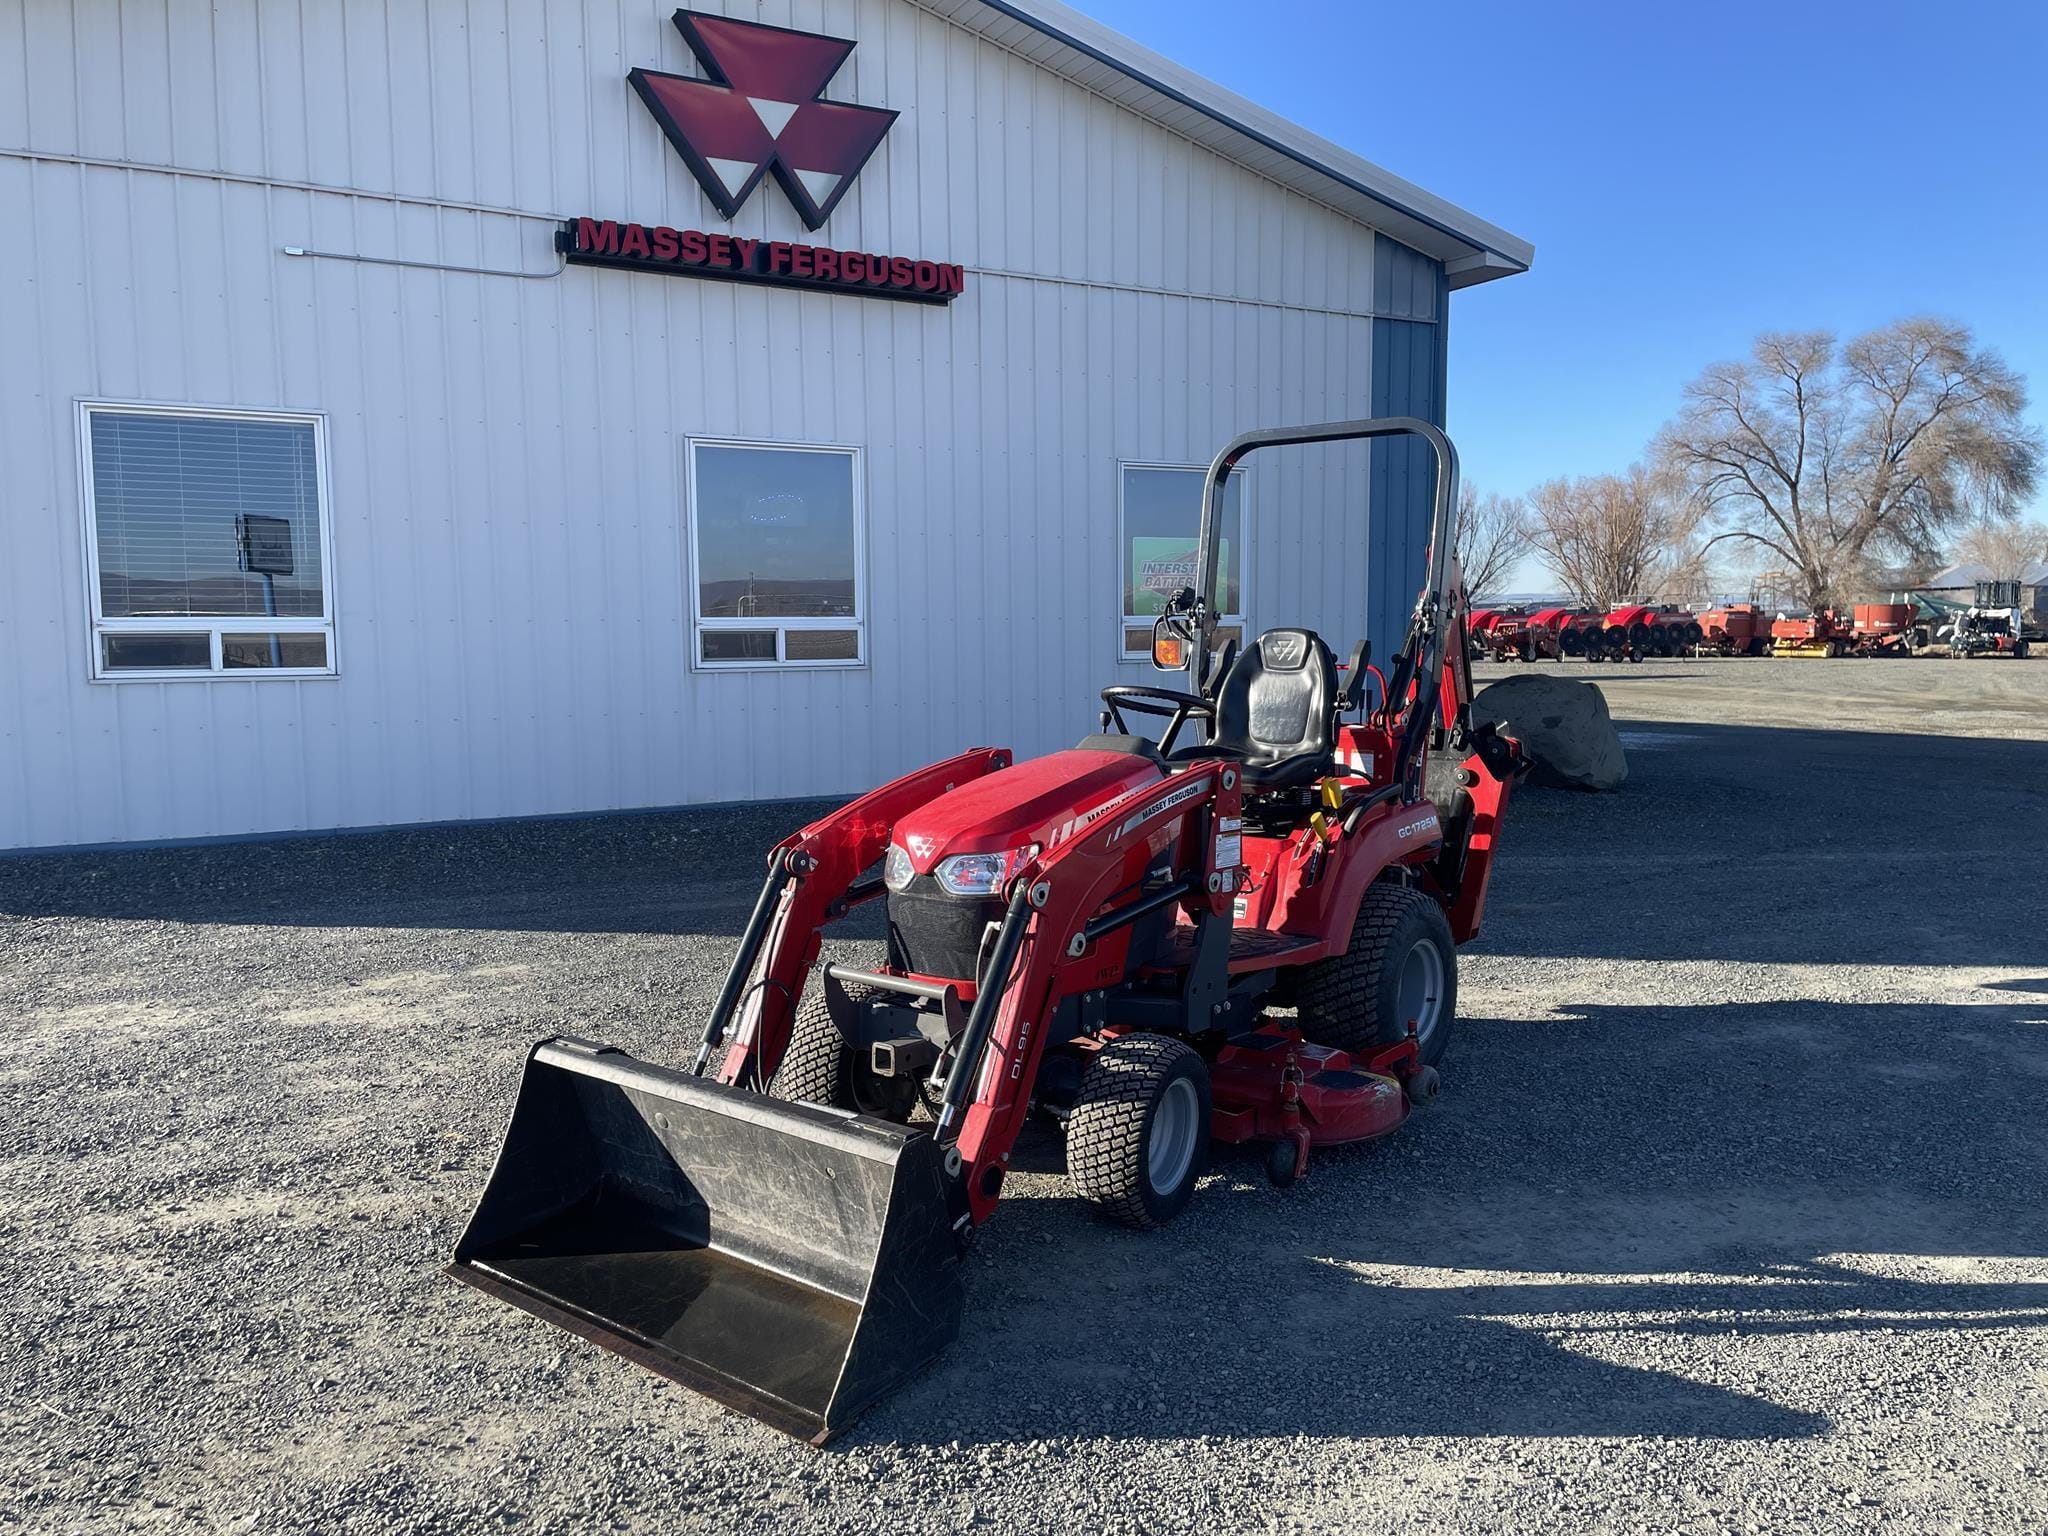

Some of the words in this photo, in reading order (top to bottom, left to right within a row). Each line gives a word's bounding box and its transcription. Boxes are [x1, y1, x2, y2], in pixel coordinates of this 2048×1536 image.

[579, 216, 759, 270] MASSEY
[768, 240, 964, 294] FERGUSON
[1142, 563, 1199, 574] INTERST
[1142, 799, 1167, 820] MASSEY
[1167, 784, 1198, 806] FERGUSON
[1011, 1021, 1030, 1080] DL95
